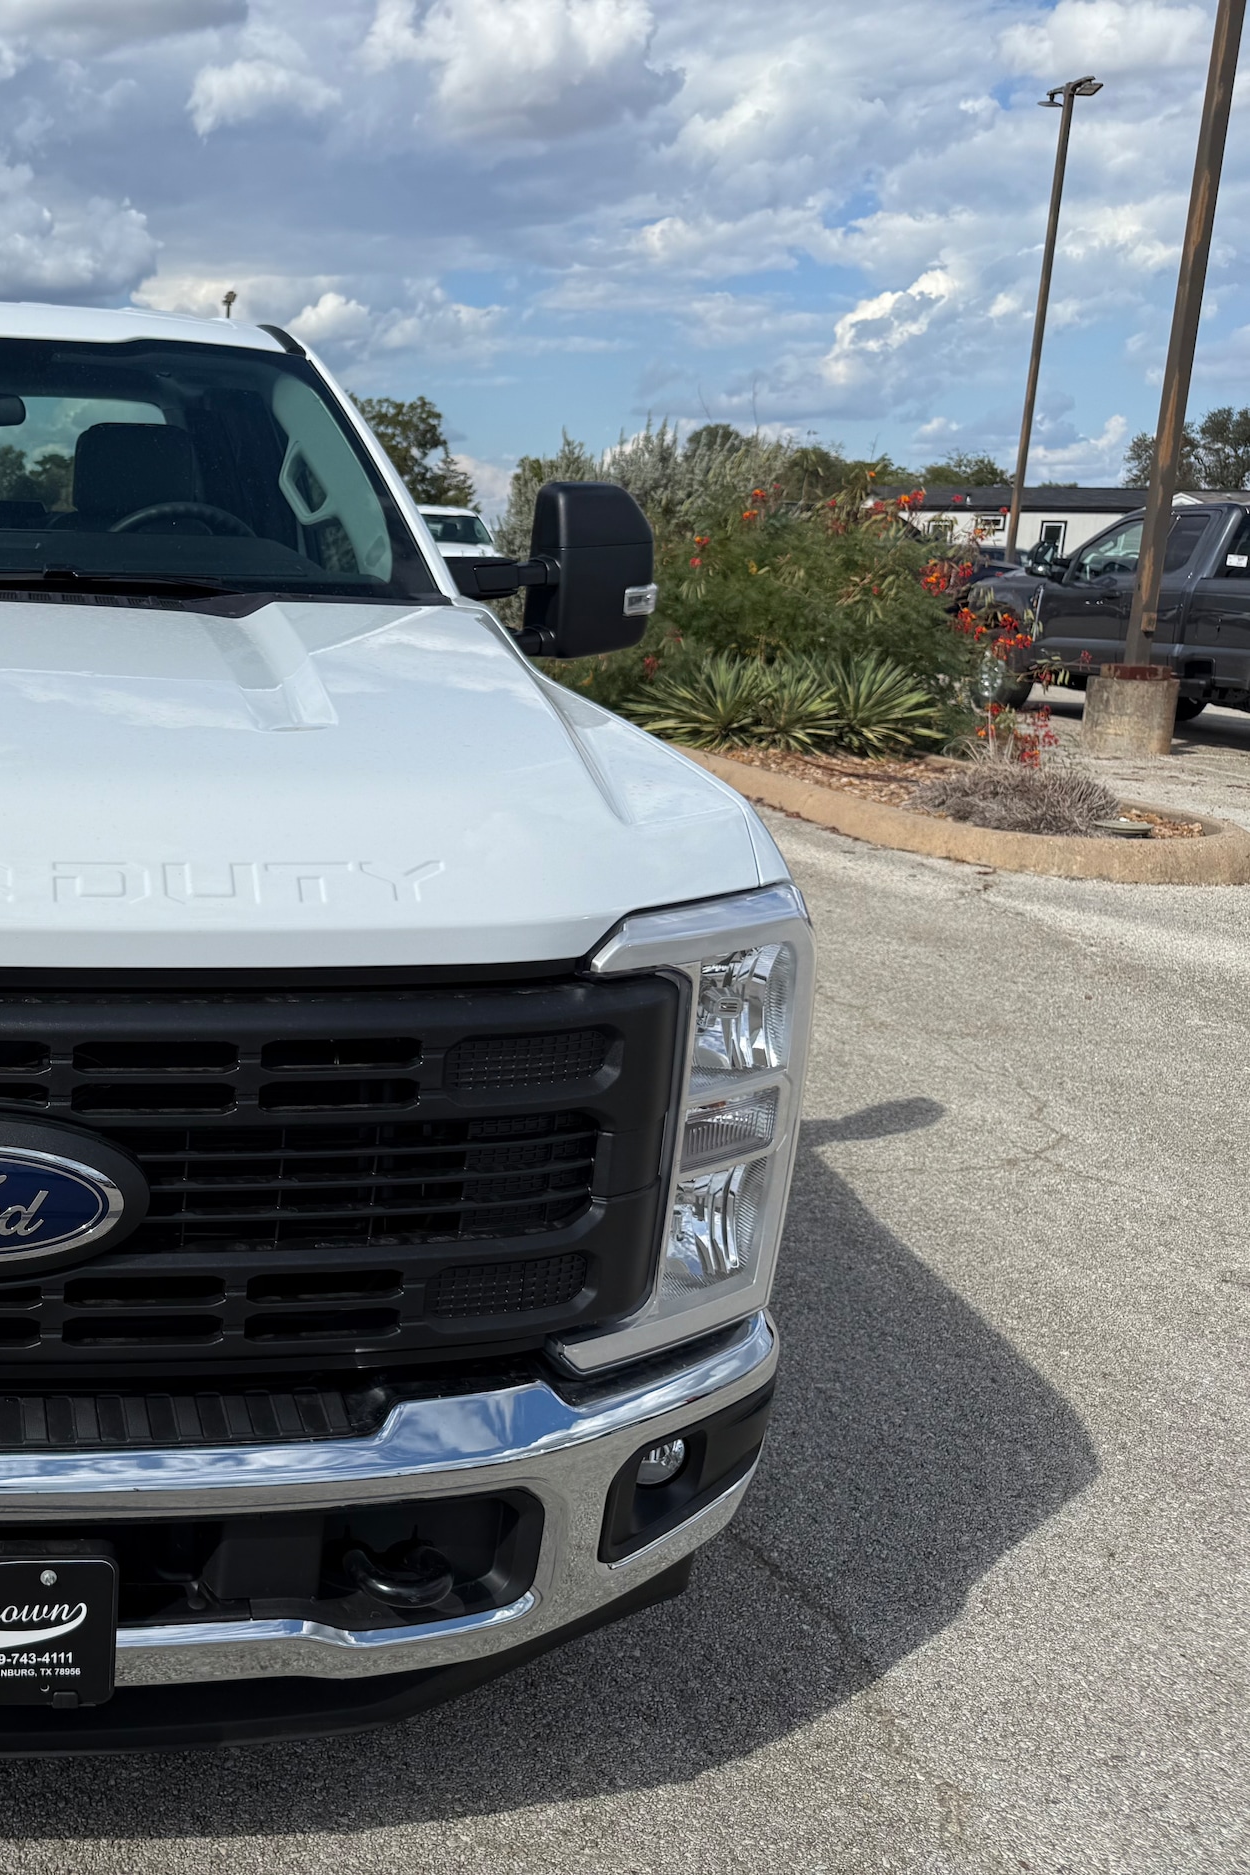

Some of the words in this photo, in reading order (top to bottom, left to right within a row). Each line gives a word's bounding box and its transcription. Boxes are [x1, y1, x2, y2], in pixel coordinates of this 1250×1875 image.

[51, 858, 446, 905] DUTY
[40, 1668, 52, 1676] TX
[54, 1667, 81, 1676] 78956
